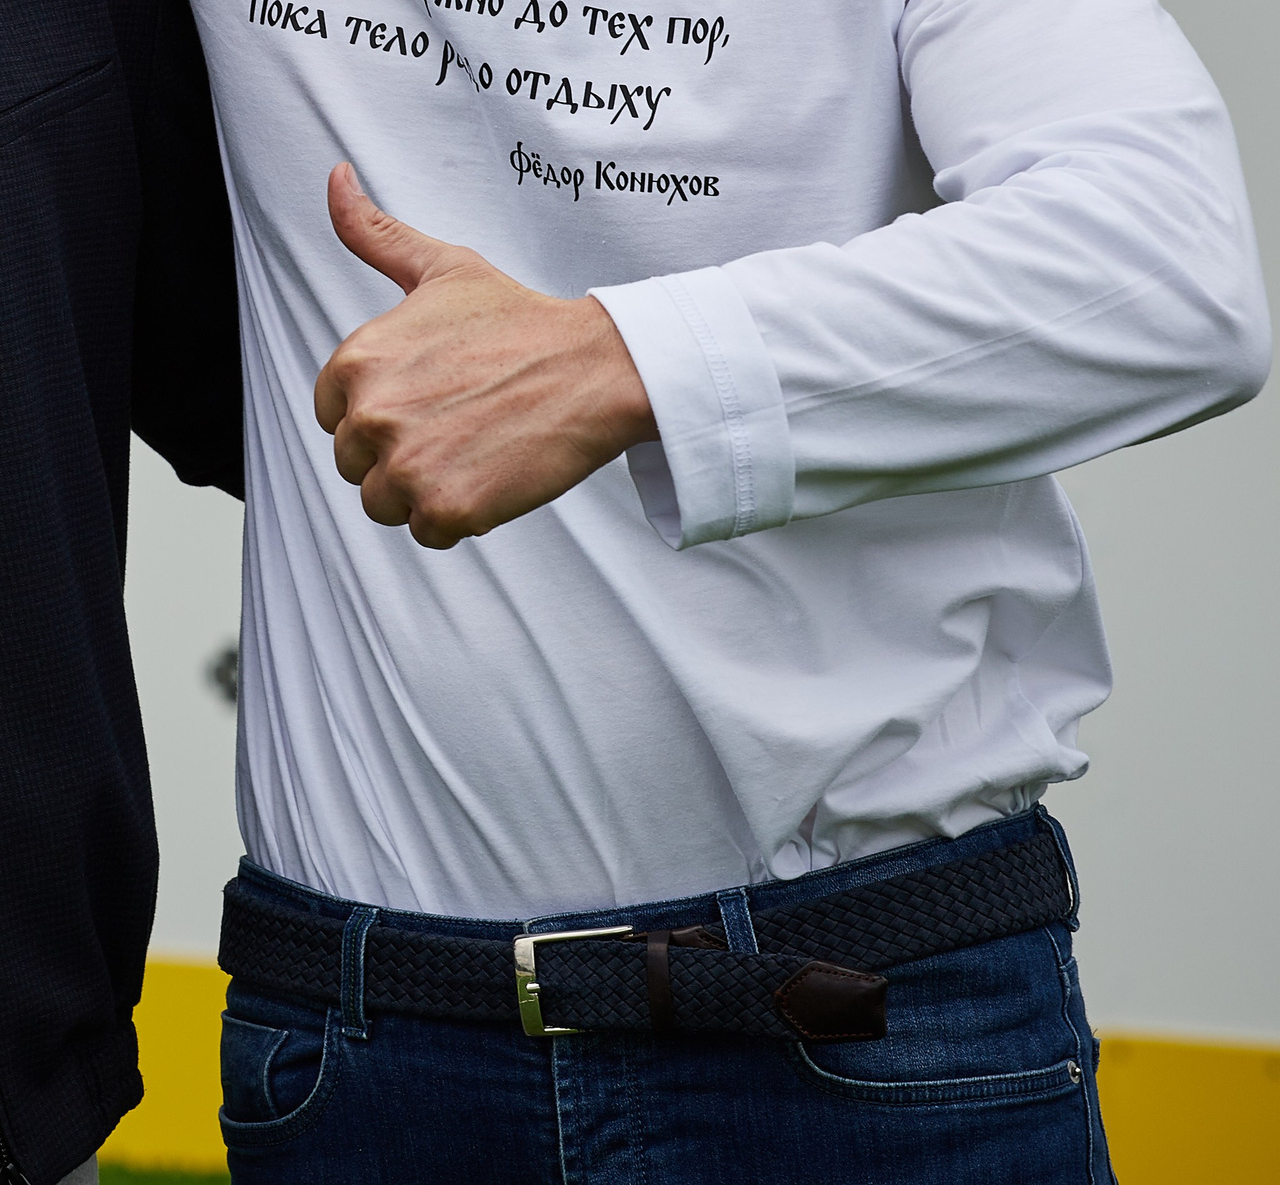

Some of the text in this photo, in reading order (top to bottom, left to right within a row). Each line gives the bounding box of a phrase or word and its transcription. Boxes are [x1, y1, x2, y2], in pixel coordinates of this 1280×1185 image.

[582, 5, 653, 56] тех
[666, 16, 730, 66] пор,
[345, 16, 430, 58] тело
[435, 39, 493, 93] ро
[505, 67, 672, 131] отдыху
[595, 160, 720, 206] Конюхов
